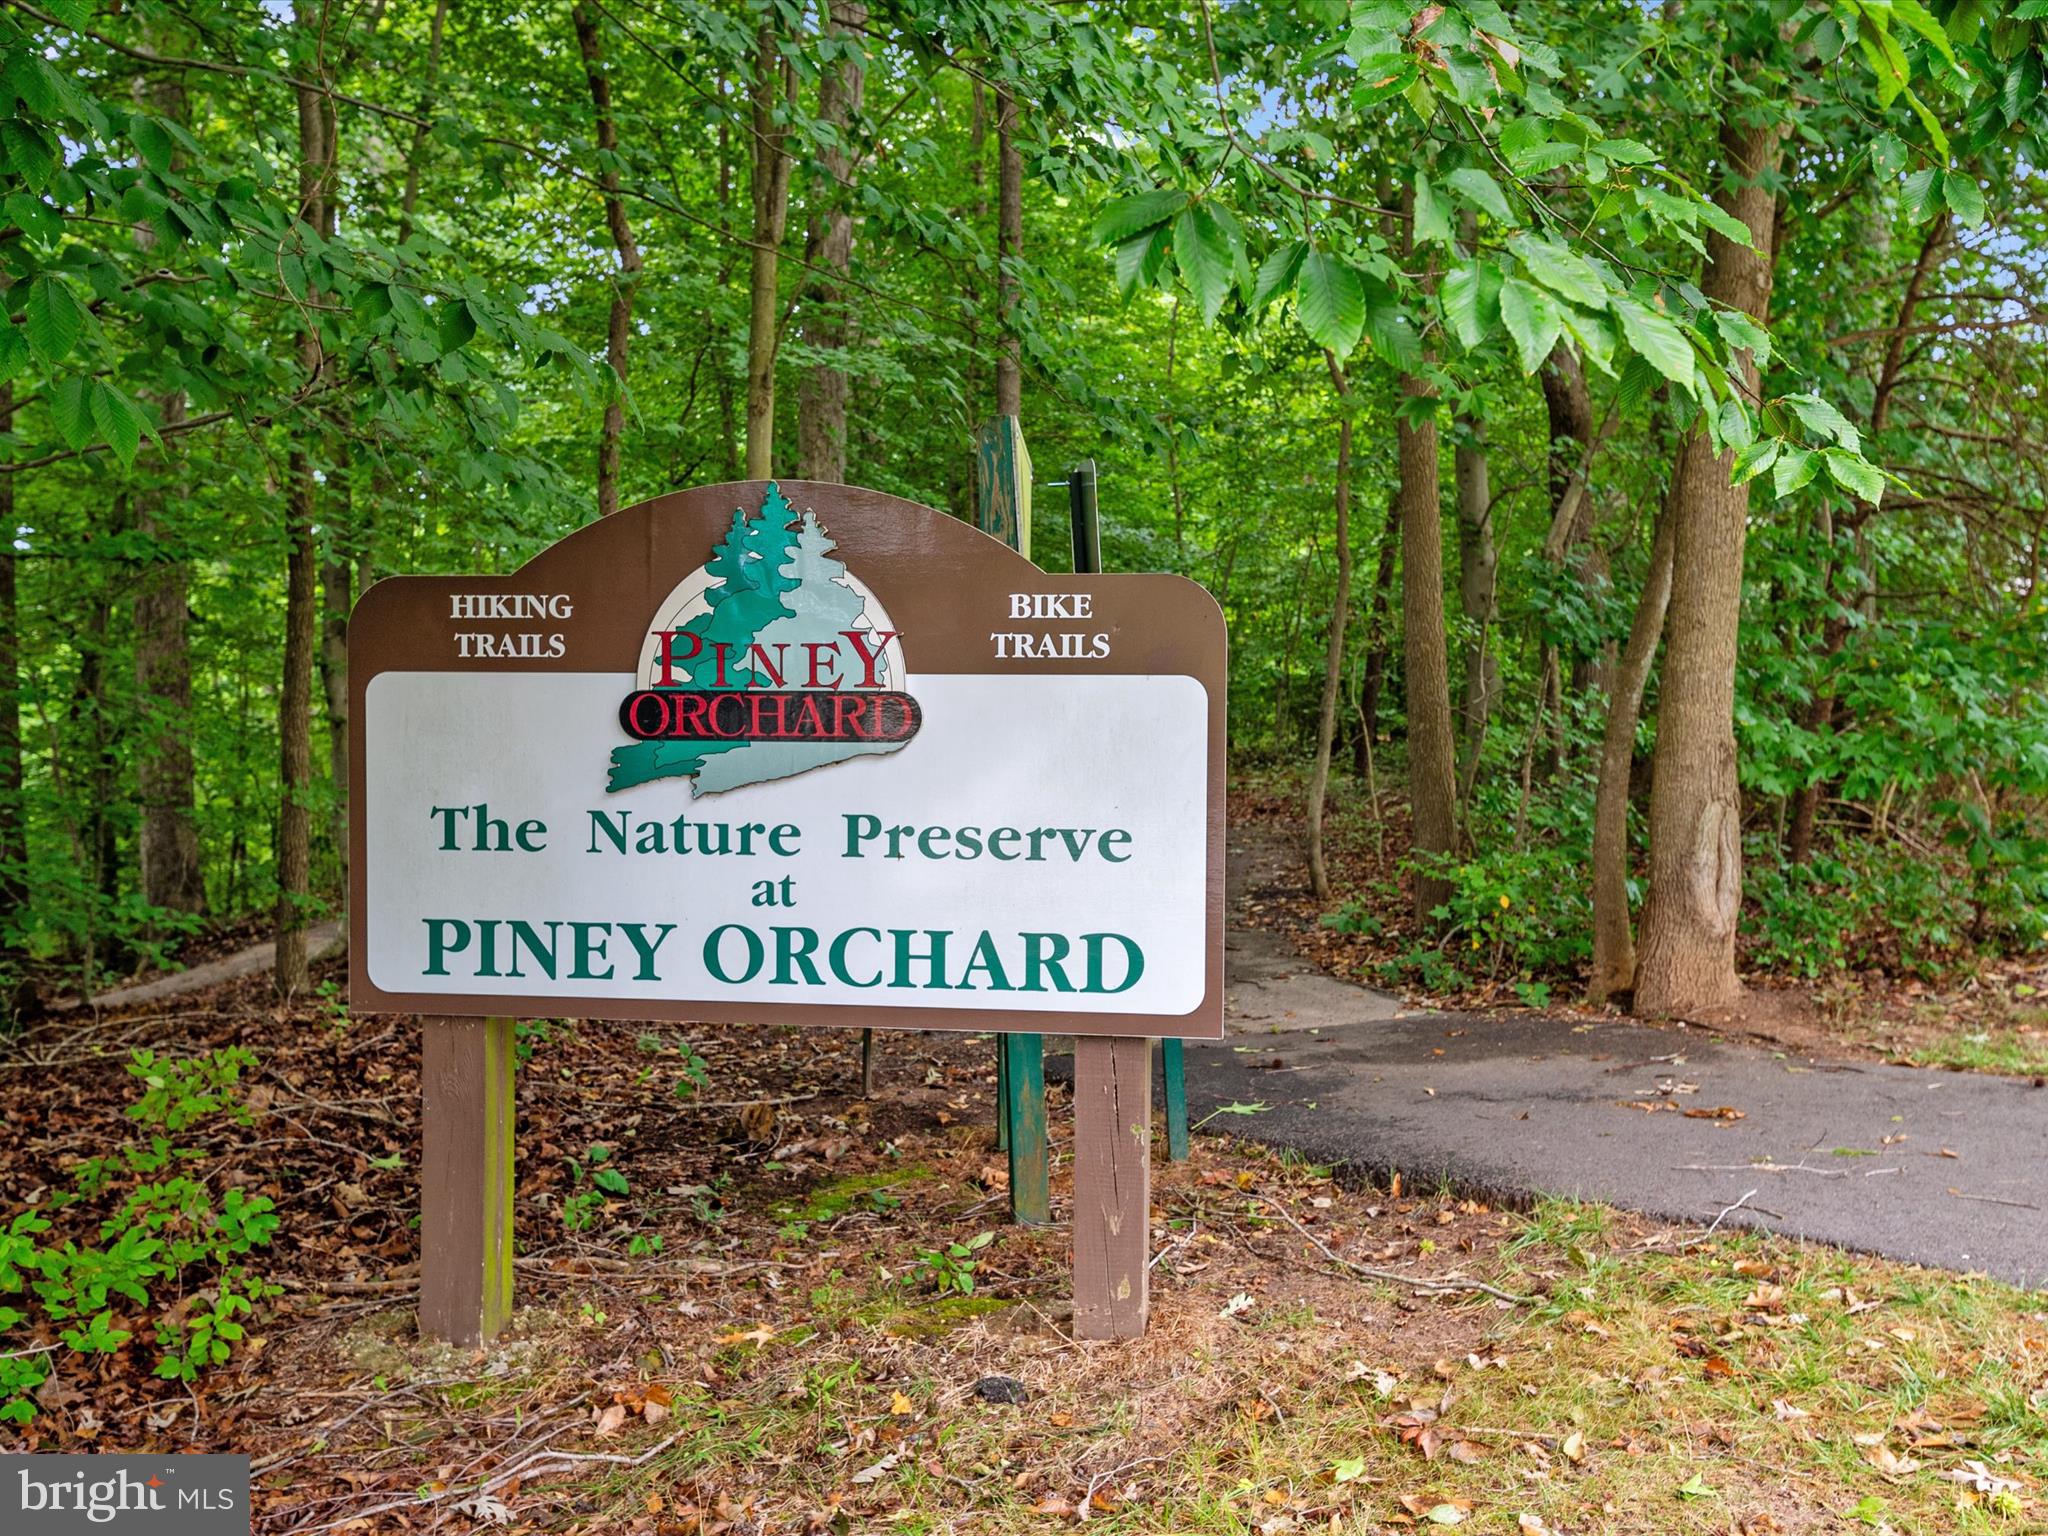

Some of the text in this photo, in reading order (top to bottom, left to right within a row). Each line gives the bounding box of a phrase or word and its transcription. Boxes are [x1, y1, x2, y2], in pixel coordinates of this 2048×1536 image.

[450, 594, 575, 619] HIKING
[1008, 593, 1093, 619] BIKE
[454, 633, 567, 659] TRAILS
[651, 630, 898, 690] PINEY
[989, 632, 1111, 659] TRAILS
[628, 692, 913, 738] ORCHARD
[430, 803, 1133, 863] The Nature Preserve
[751, 873, 797, 908] at
[421, 918, 1145, 994] PINEY ORCHARD
